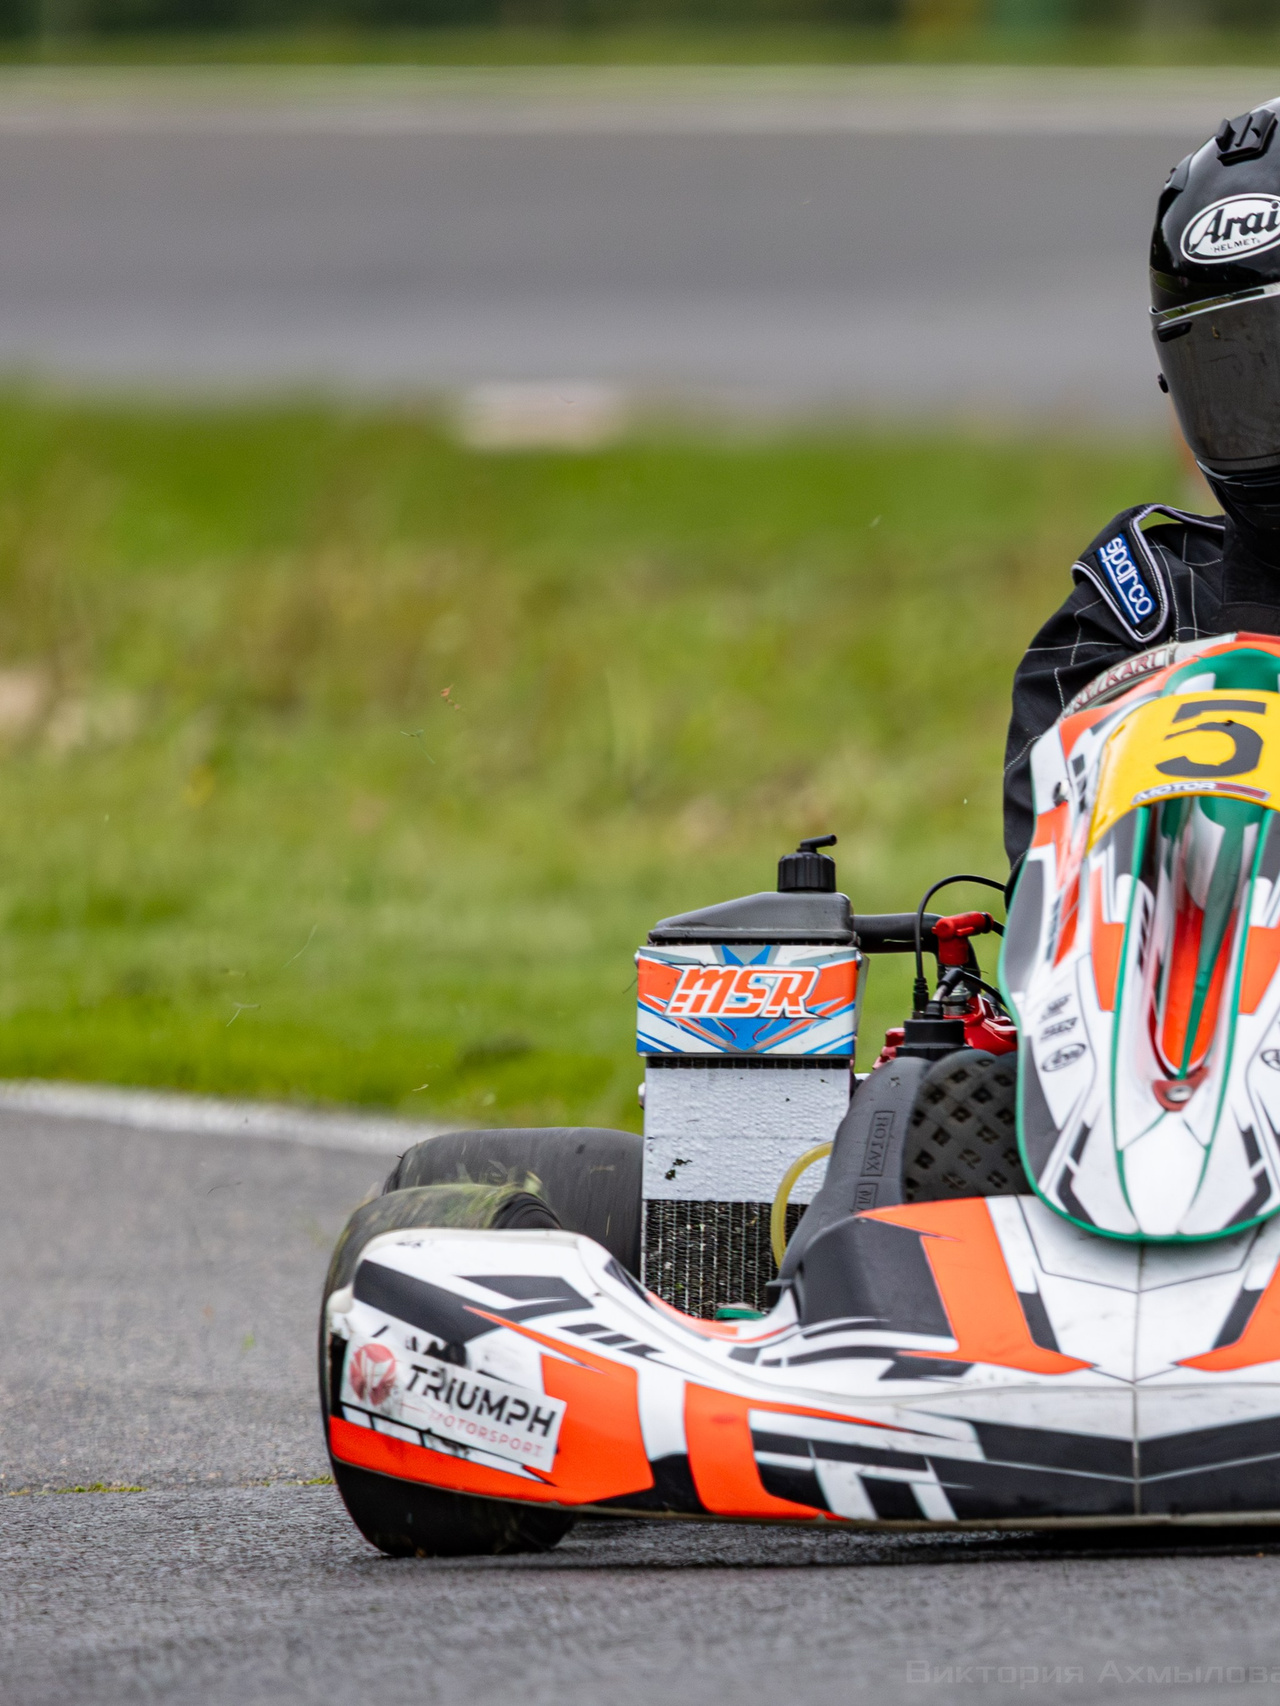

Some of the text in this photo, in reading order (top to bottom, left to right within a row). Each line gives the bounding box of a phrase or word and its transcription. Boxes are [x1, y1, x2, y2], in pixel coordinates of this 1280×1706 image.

[1213, 237, 1257, 253] HELMET
[1102, 536, 1153, 616] sparco
[1155, 699, 1267, 778] 5
[668, 966, 817, 1016] MSR
[405, 1363, 556, 1438] TRIUMPH
[428, 1410, 544, 1458] MOTORSPORT
